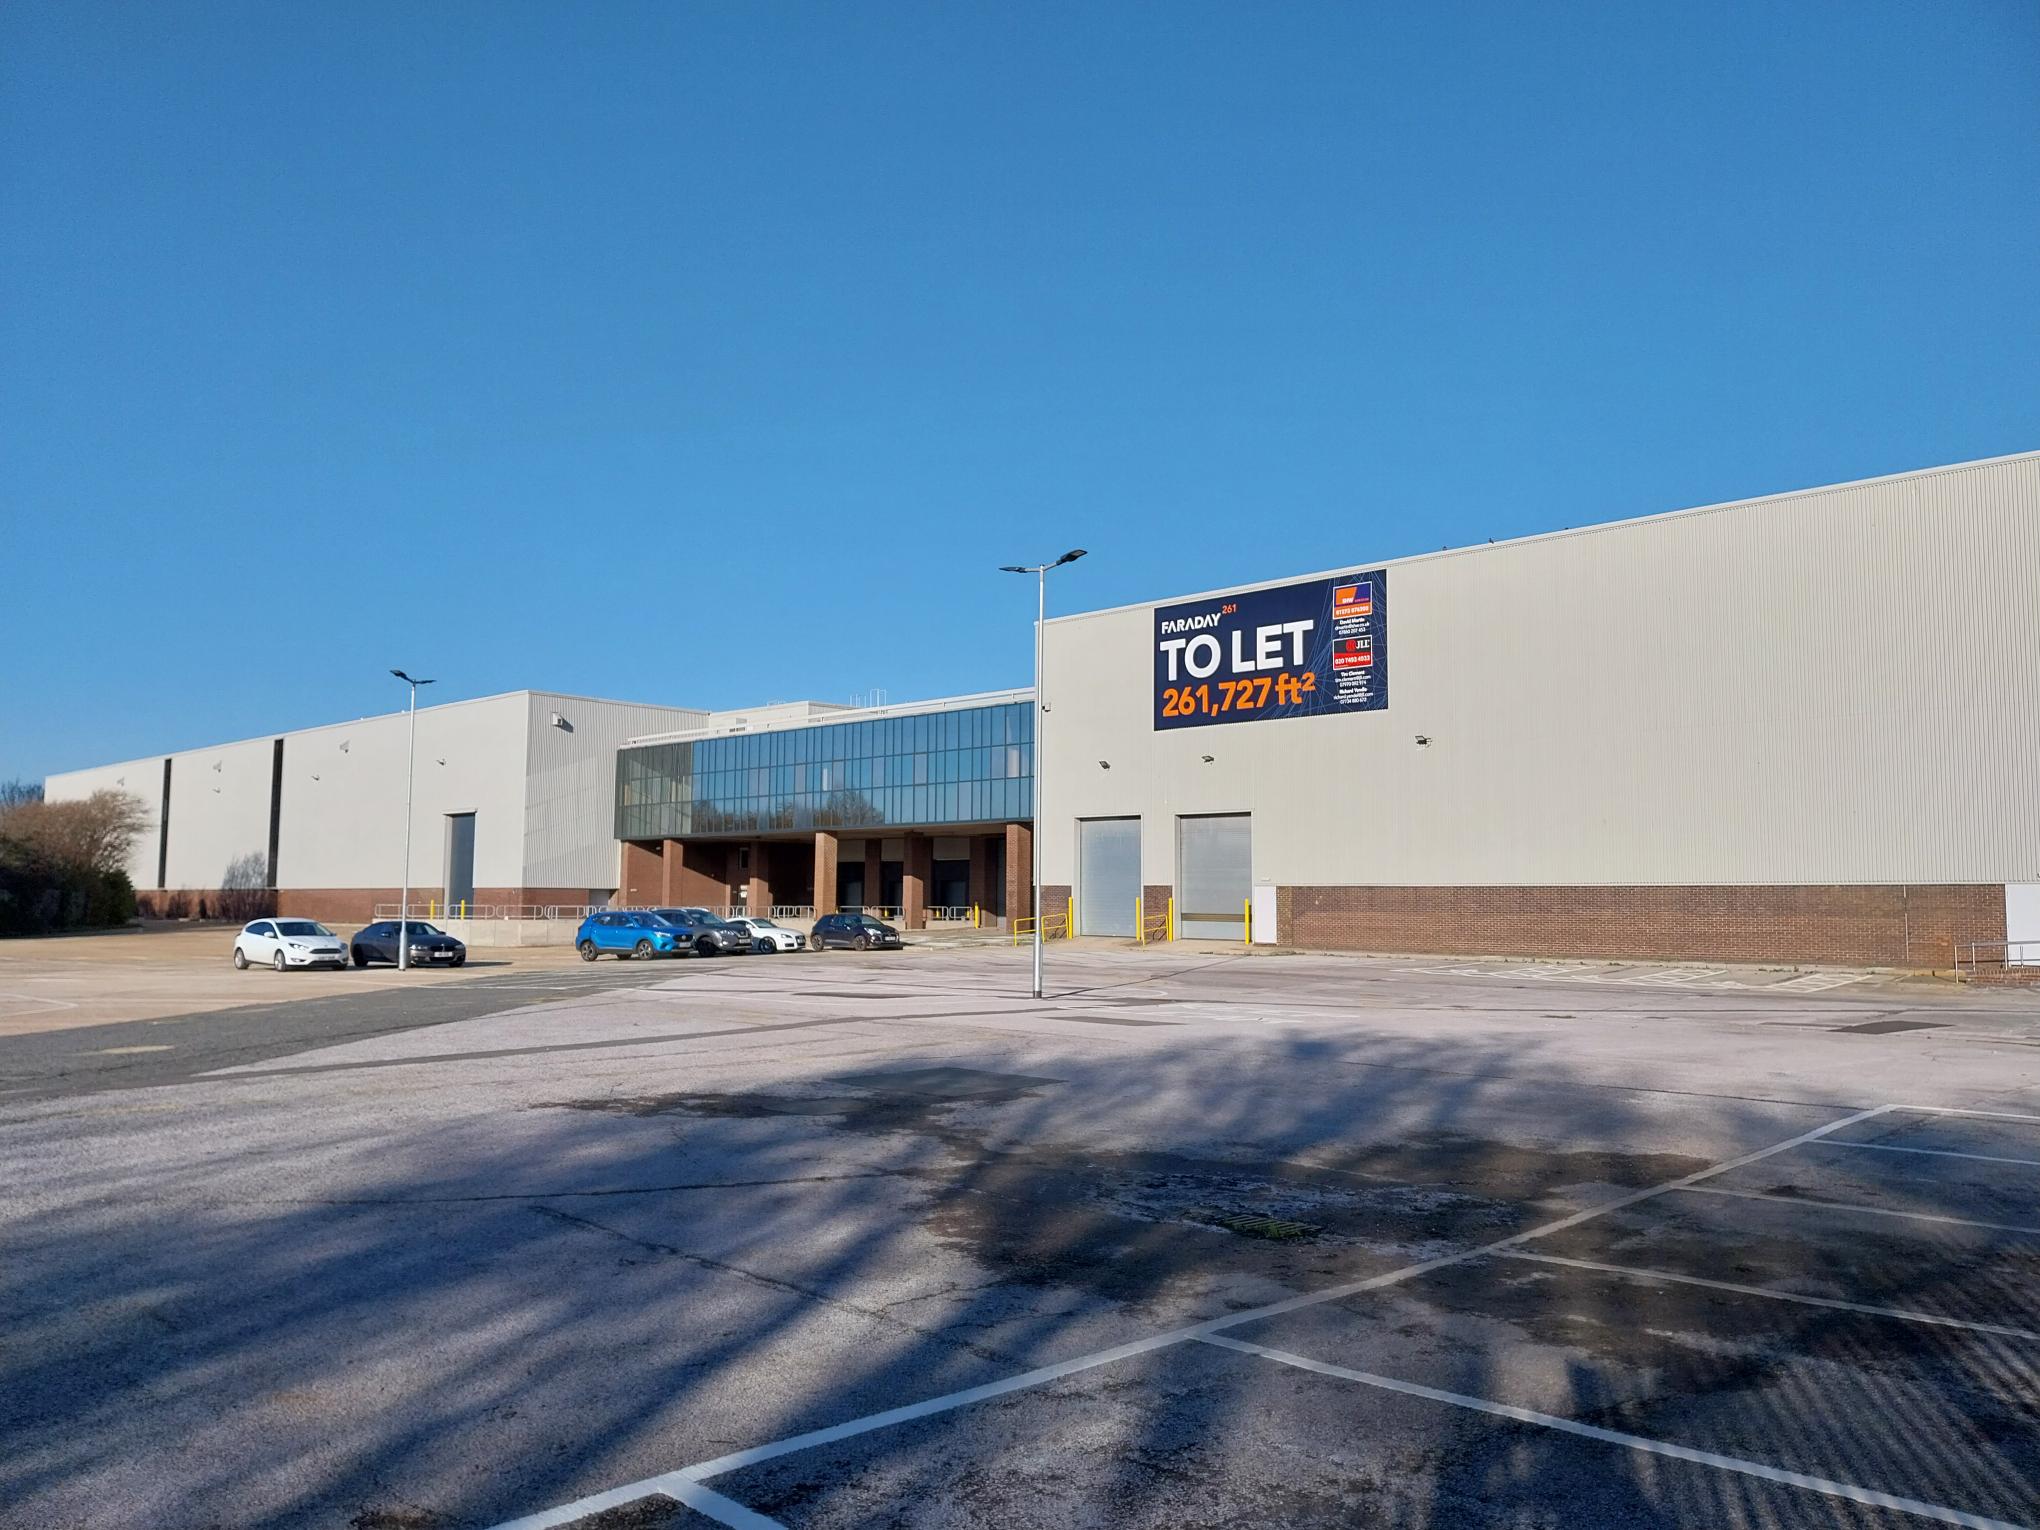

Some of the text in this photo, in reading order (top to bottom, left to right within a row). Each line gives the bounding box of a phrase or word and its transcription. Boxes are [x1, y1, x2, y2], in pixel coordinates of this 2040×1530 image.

[1161, 604, 1237, 634] FARADAY 261
[1159, 620, 1314, 681] TO LET
[1356, 640, 1370, 649] JLL
[1162, 677, 1272, 717] 261,727
